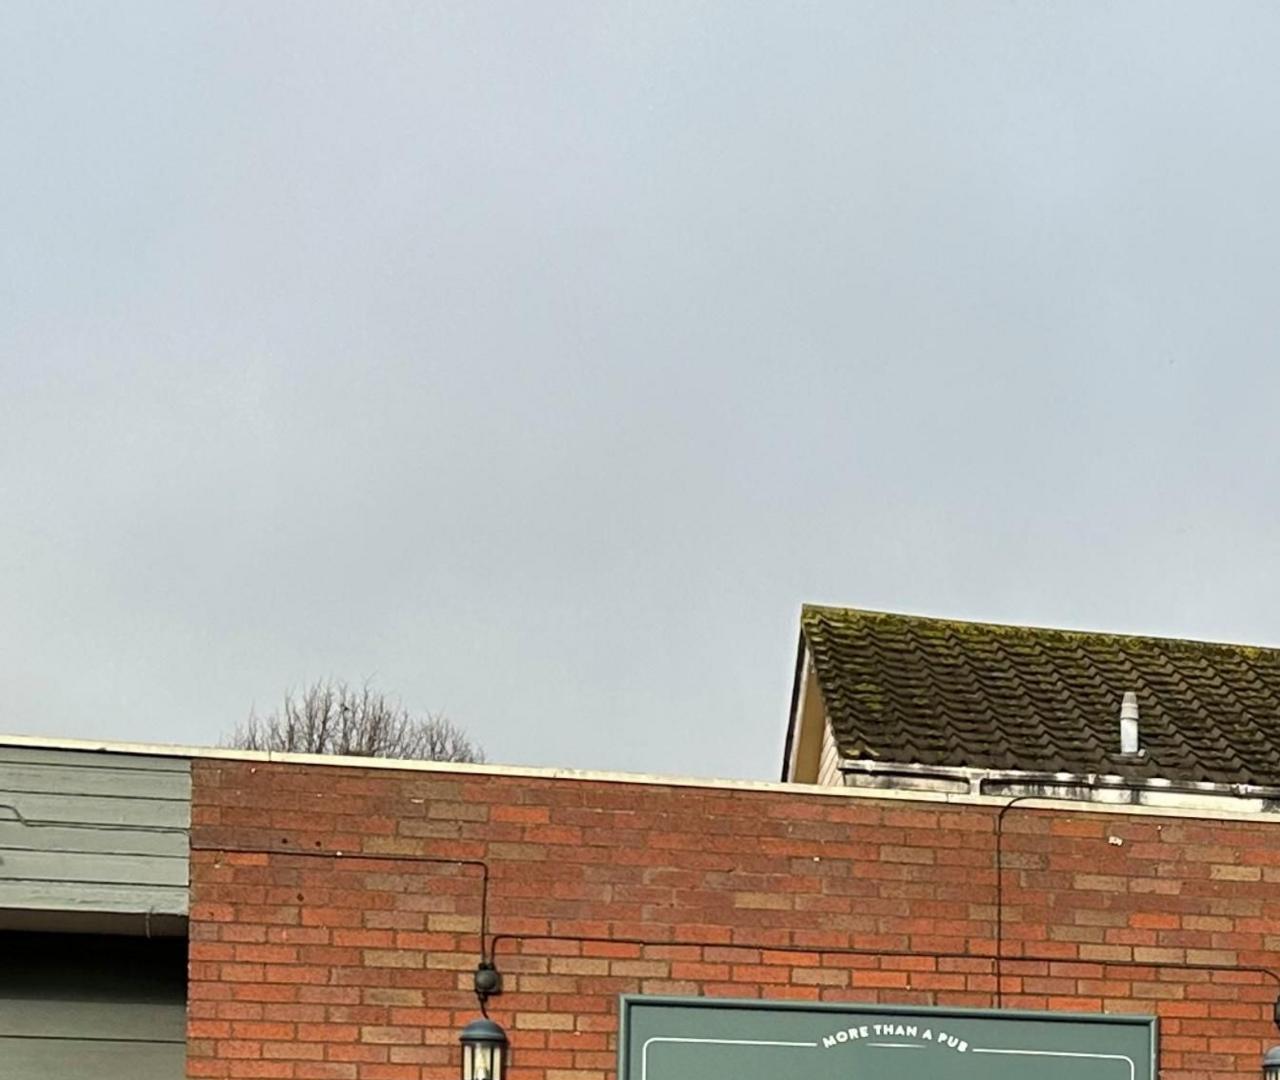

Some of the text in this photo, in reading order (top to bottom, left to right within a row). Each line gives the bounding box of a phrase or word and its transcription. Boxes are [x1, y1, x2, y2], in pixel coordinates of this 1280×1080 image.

[822, 1023, 969, 1052] MORE THAN A PUB
